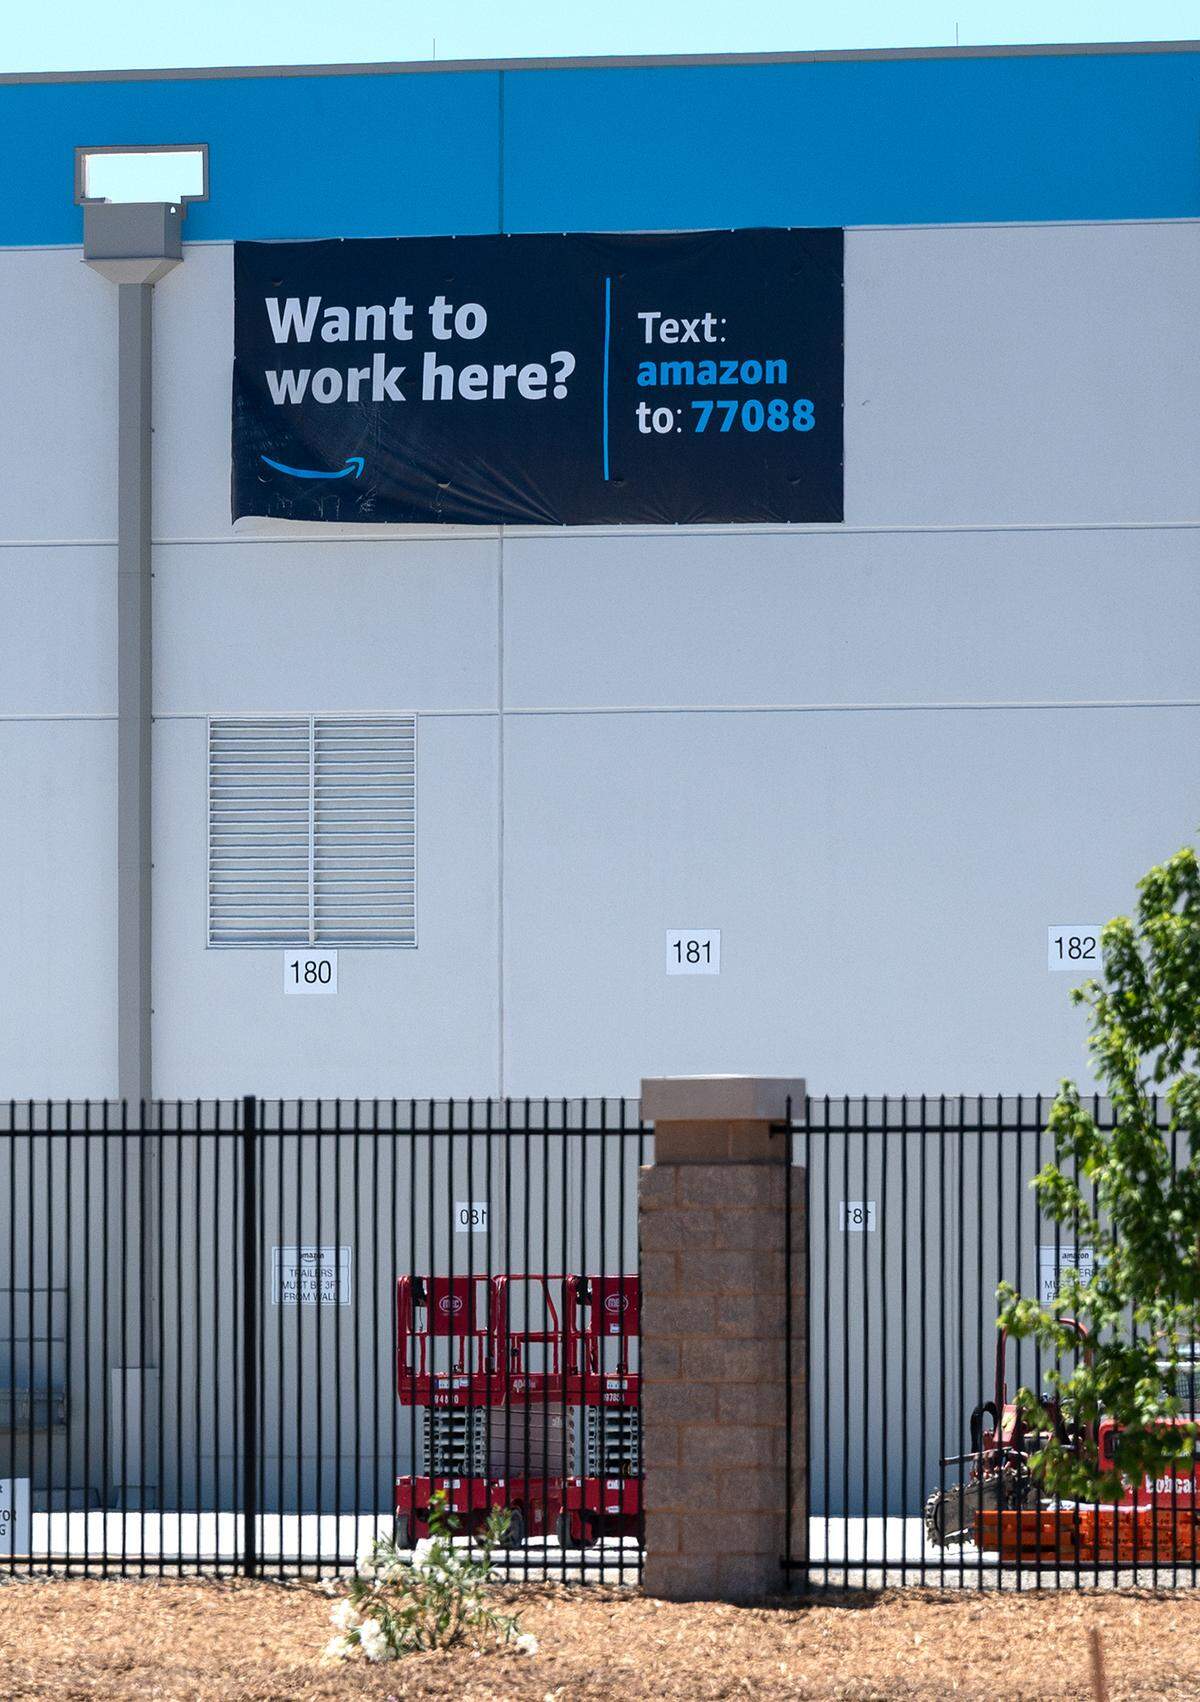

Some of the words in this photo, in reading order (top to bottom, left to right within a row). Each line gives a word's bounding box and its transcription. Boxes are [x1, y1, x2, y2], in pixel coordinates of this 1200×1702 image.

[265, 296, 413, 343] Want
[429, 296, 487, 340] to
[638, 312, 726, 343] Text:
[265, 353, 406, 404] work
[422, 351, 575, 400] here?
[637, 359, 787, 386] amazon
[636, 402, 682, 433] to:
[692, 400, 815, 432] 77088
[673, 940, 710, 963] 181
[1055, 937, 1096, 959] 182
[291, 960, 331, 983] 180
[282, 1281, 307, 1289] MUT
[283, 1293, 310, 1301] FRM
